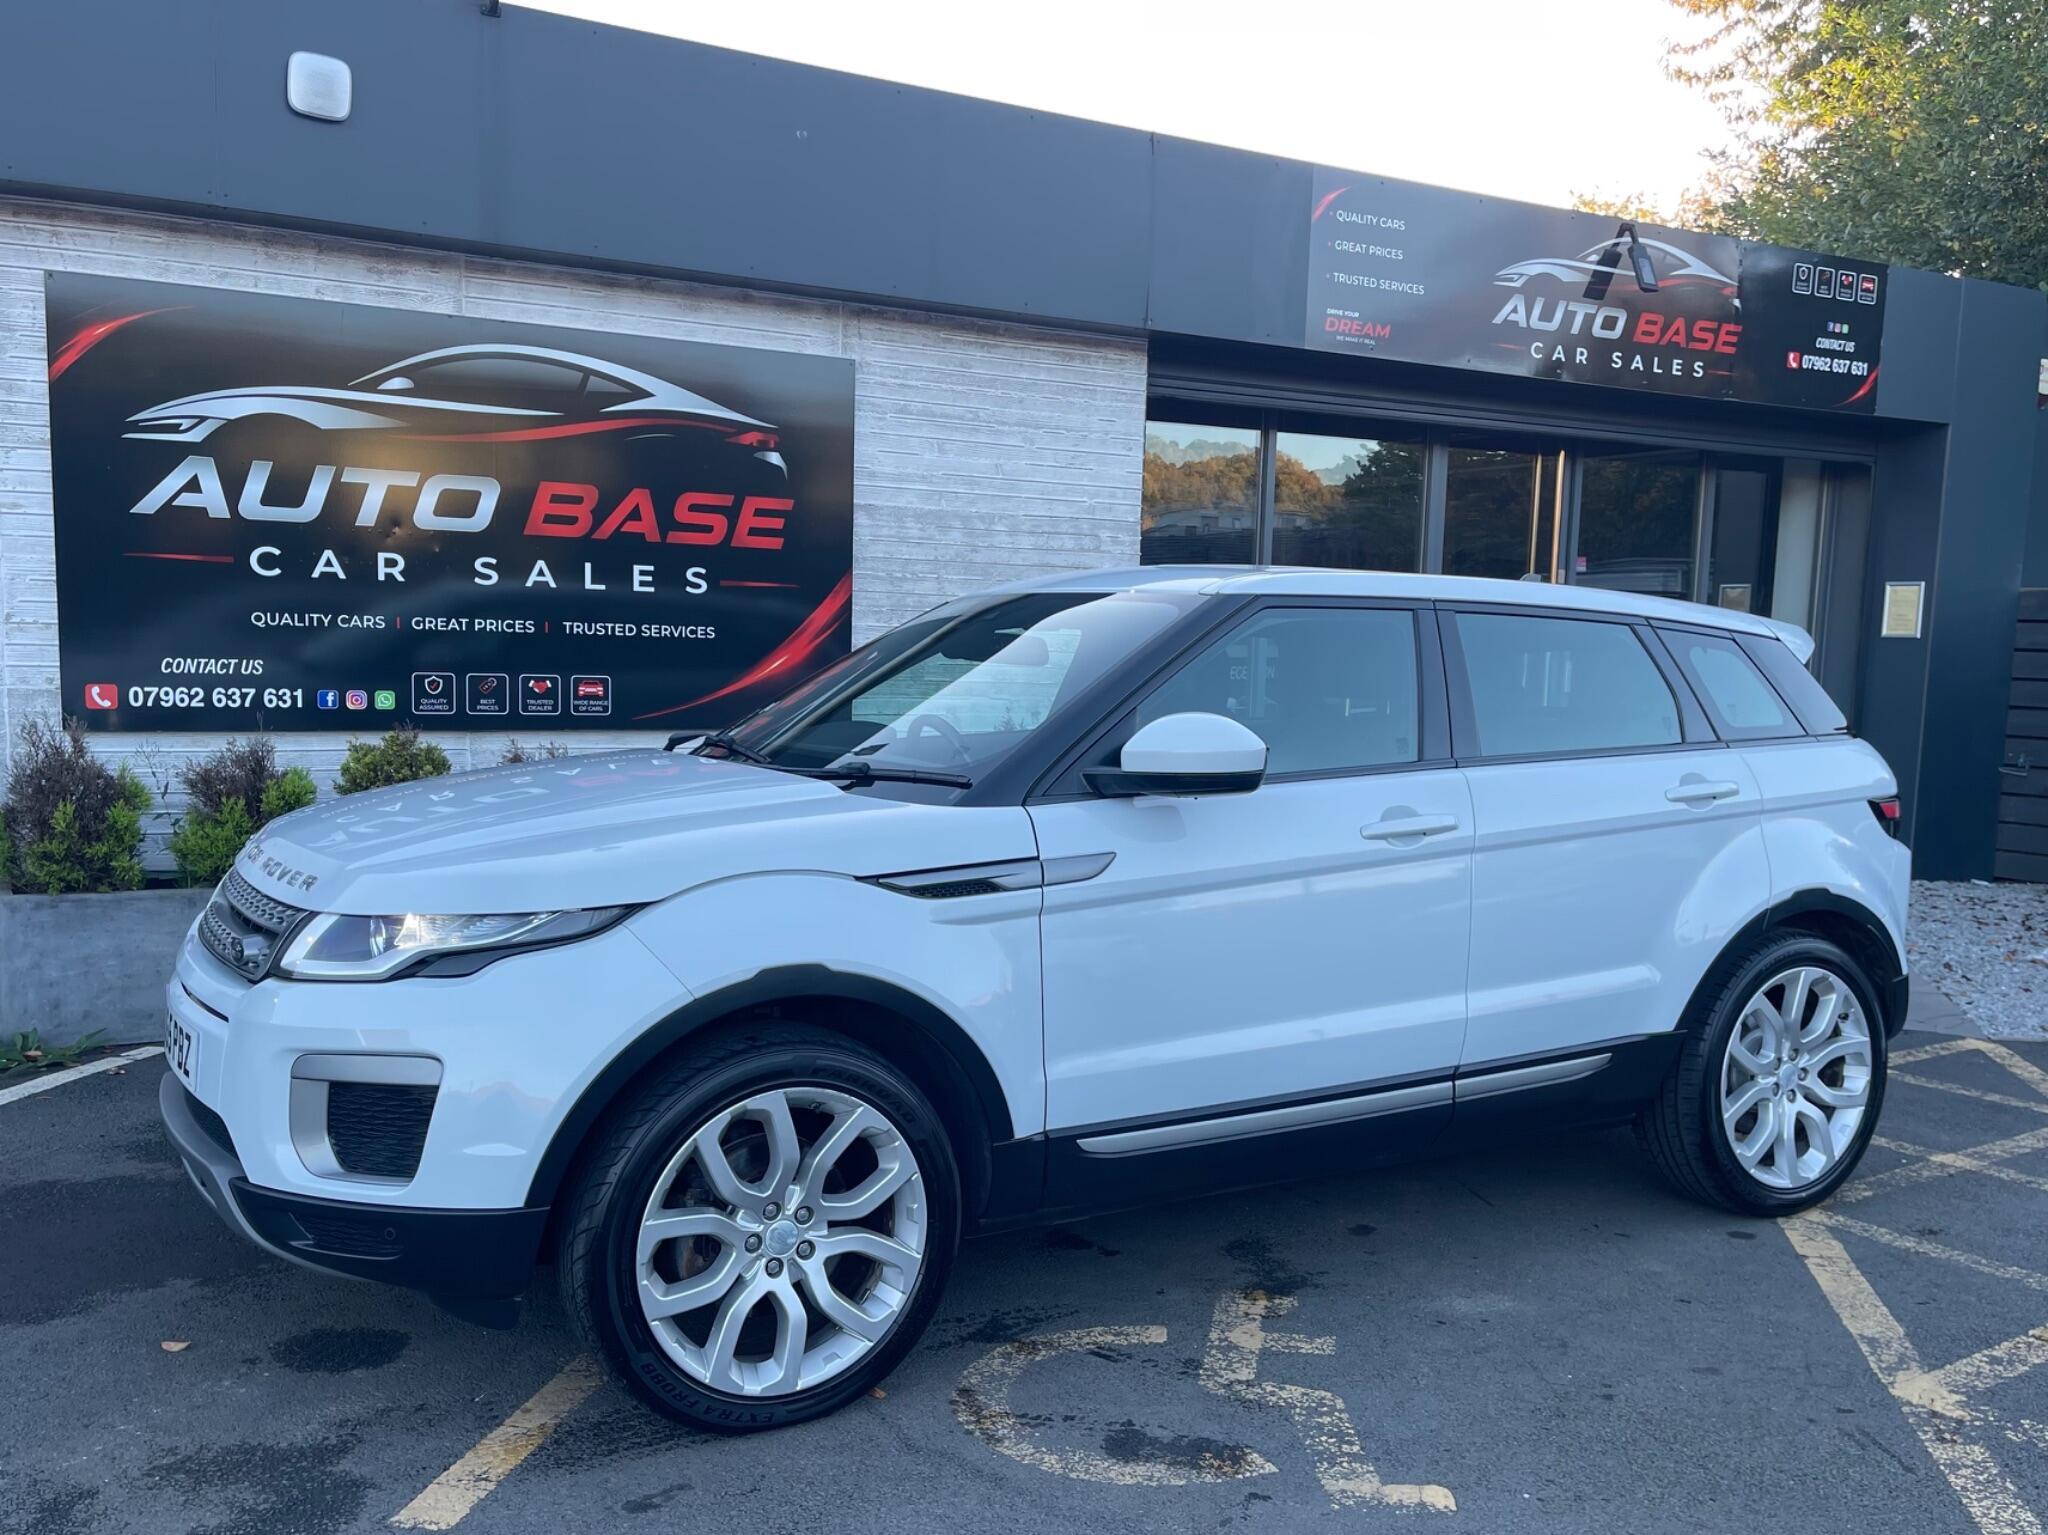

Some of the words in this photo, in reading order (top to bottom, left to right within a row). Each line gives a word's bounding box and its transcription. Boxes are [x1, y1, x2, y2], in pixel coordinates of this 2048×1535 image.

[1336, 210, 1379, 226] QUALITY
[1380, 218, 1406, 231] CARS
[1335, 240, 1367, 254] GREAT
[1369, 245, 1404, 260] PRICES
[1333, 272, 1377, 288] TRUSTED
[1379, 279, 1425, 295] SERVICES
[1324, 317, 1391, 338] DREAM
[1491, 293, 1628, 340] AUTO
[1632, 312, 1743, 354] BASE
[1815, 337, 1845, 351] CONTACT
[1845, 341, 1856, 353] US
[1530, 342, 1588, 365] CAR
[1611, 352, 1704, 378] SALES
[1802, 355, 1831, 372] 07962
[1832, 359, 1851, 374] 637
[1851, 361, 1868, 376] 631
[130, 455, 501, 533] AUTO
[523, 481, 794, 549] BASE
[248, 545, 406, 582] CAR
[473, 556, 708, 594] SALES
[250, 611, 332, 629] QUALITY
[337, 614, 386, 629] CARS
[411, 616, 470, 632] GREAT
[474, 618, 535, 633] PRICES
[562, 621, 637, 637] TRUSTED
[640, 623, 716, 639] SERVICES
[161, 657, 238, 675] CONTACT
[241, 659, 264, 675] US
[128, 686, 205, 707] 07962
[212, 688, 257, 708] 637
[263, 688, 303, 708] 631
[260, 856, 319, 892] ROVER
